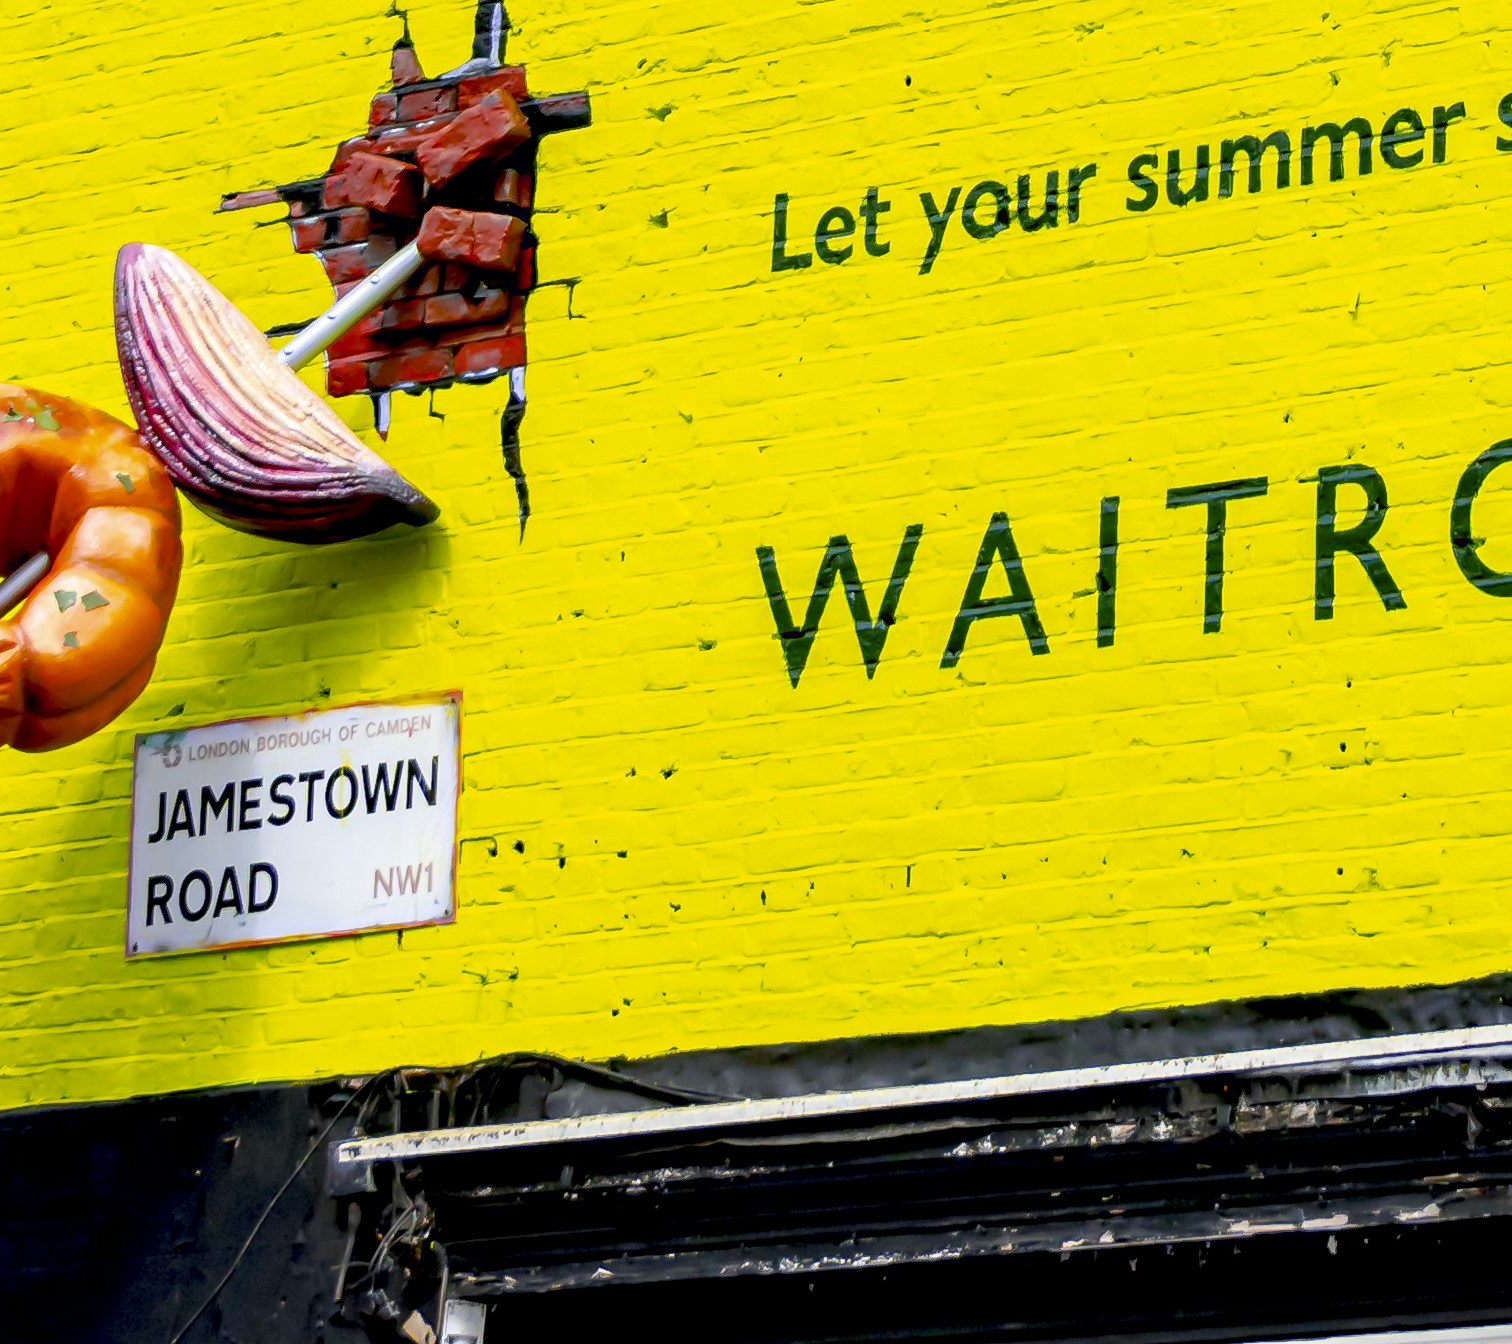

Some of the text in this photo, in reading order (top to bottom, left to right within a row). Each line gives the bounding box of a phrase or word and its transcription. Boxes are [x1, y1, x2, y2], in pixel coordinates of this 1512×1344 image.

[771, 185, 892, 272] Let
[919, 162, 1097, 275] your
[1126, 101, 1466, 212] summer
[188, 714, 432, 761] LONDON BOROUGH OF CAMDEN
[147, 755, 439, 844] JAMESTOWN
[145, 861, 434, 927] ROAD NW1
